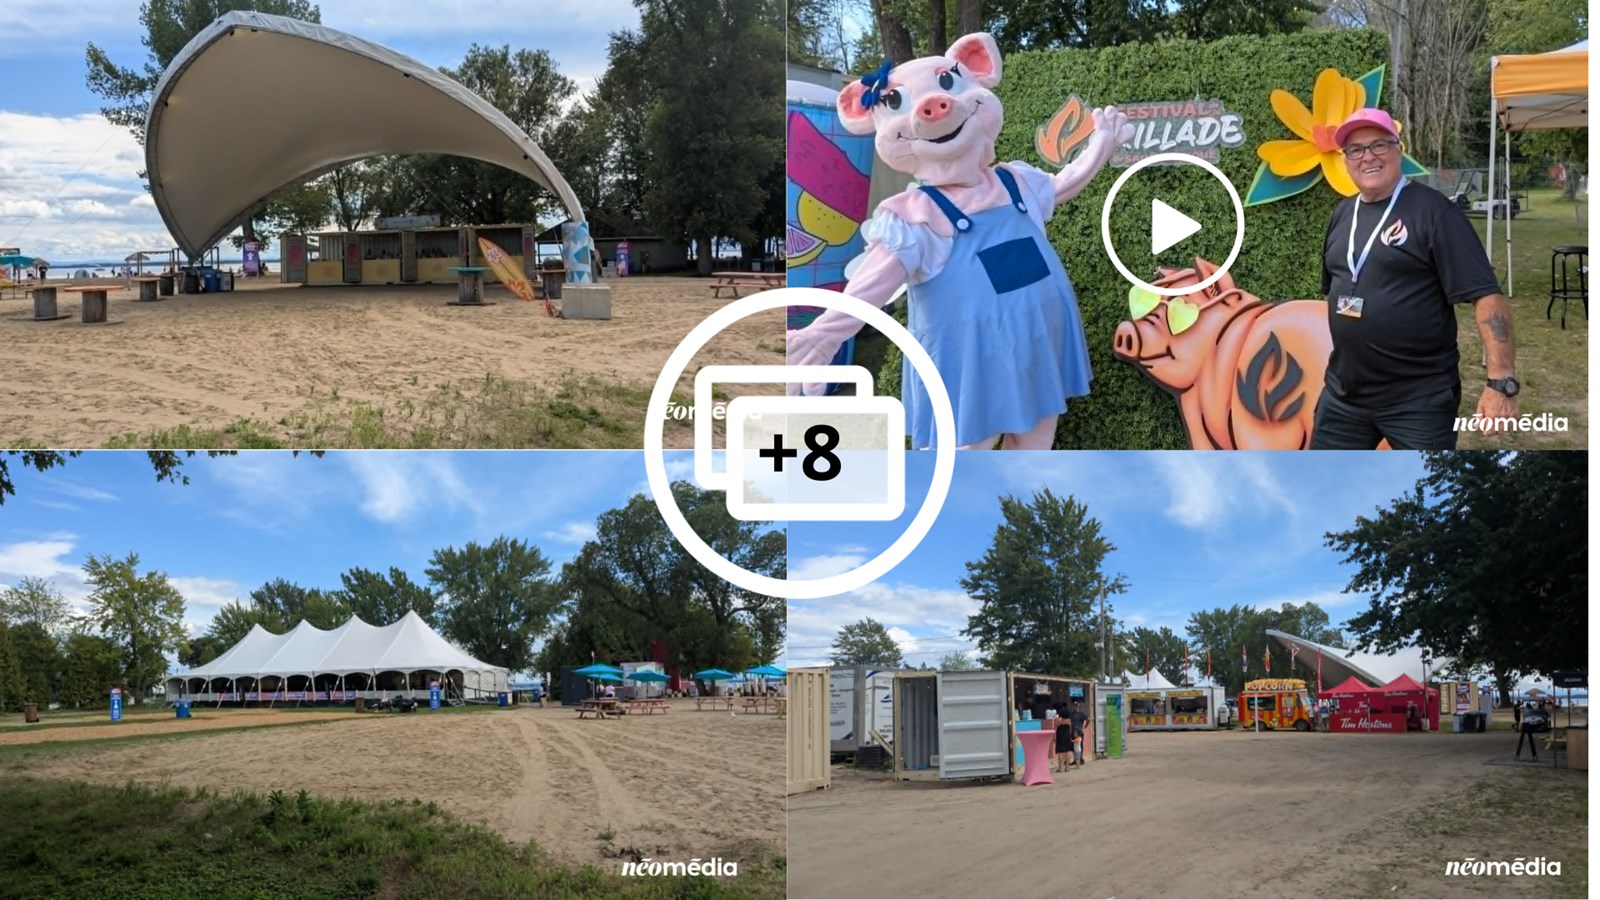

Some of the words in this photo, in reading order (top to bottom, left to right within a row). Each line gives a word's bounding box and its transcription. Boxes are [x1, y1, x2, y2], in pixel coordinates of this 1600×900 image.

[1122, 115, 1243, 151] ILLADE
[1244, 682, 1293, 691] POPCORN
[1340, 717, 1356, 729] Tim
